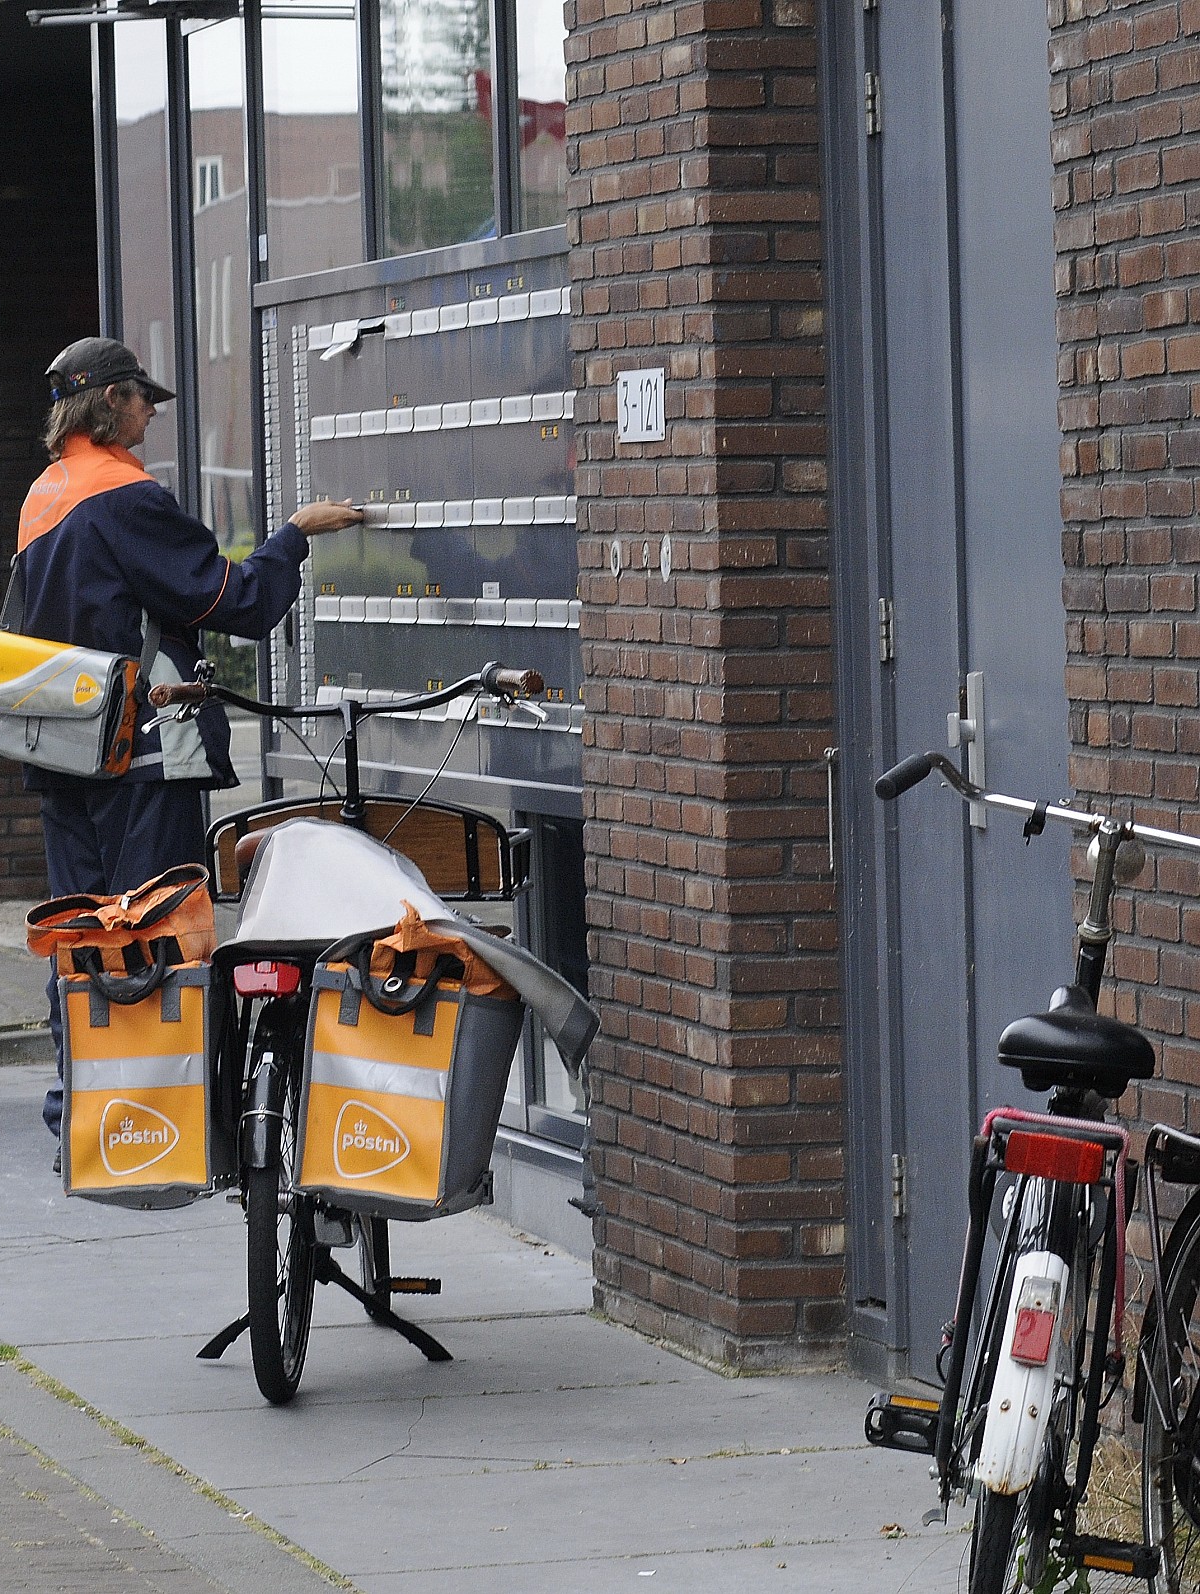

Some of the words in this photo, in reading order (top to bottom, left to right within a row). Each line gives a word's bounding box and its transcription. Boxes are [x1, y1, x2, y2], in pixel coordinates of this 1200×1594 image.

[622, 377, 658, 433] 3-121
[108, 1124, 168, 1151] postnl
[341, 1131, 400, 1154] postnl
